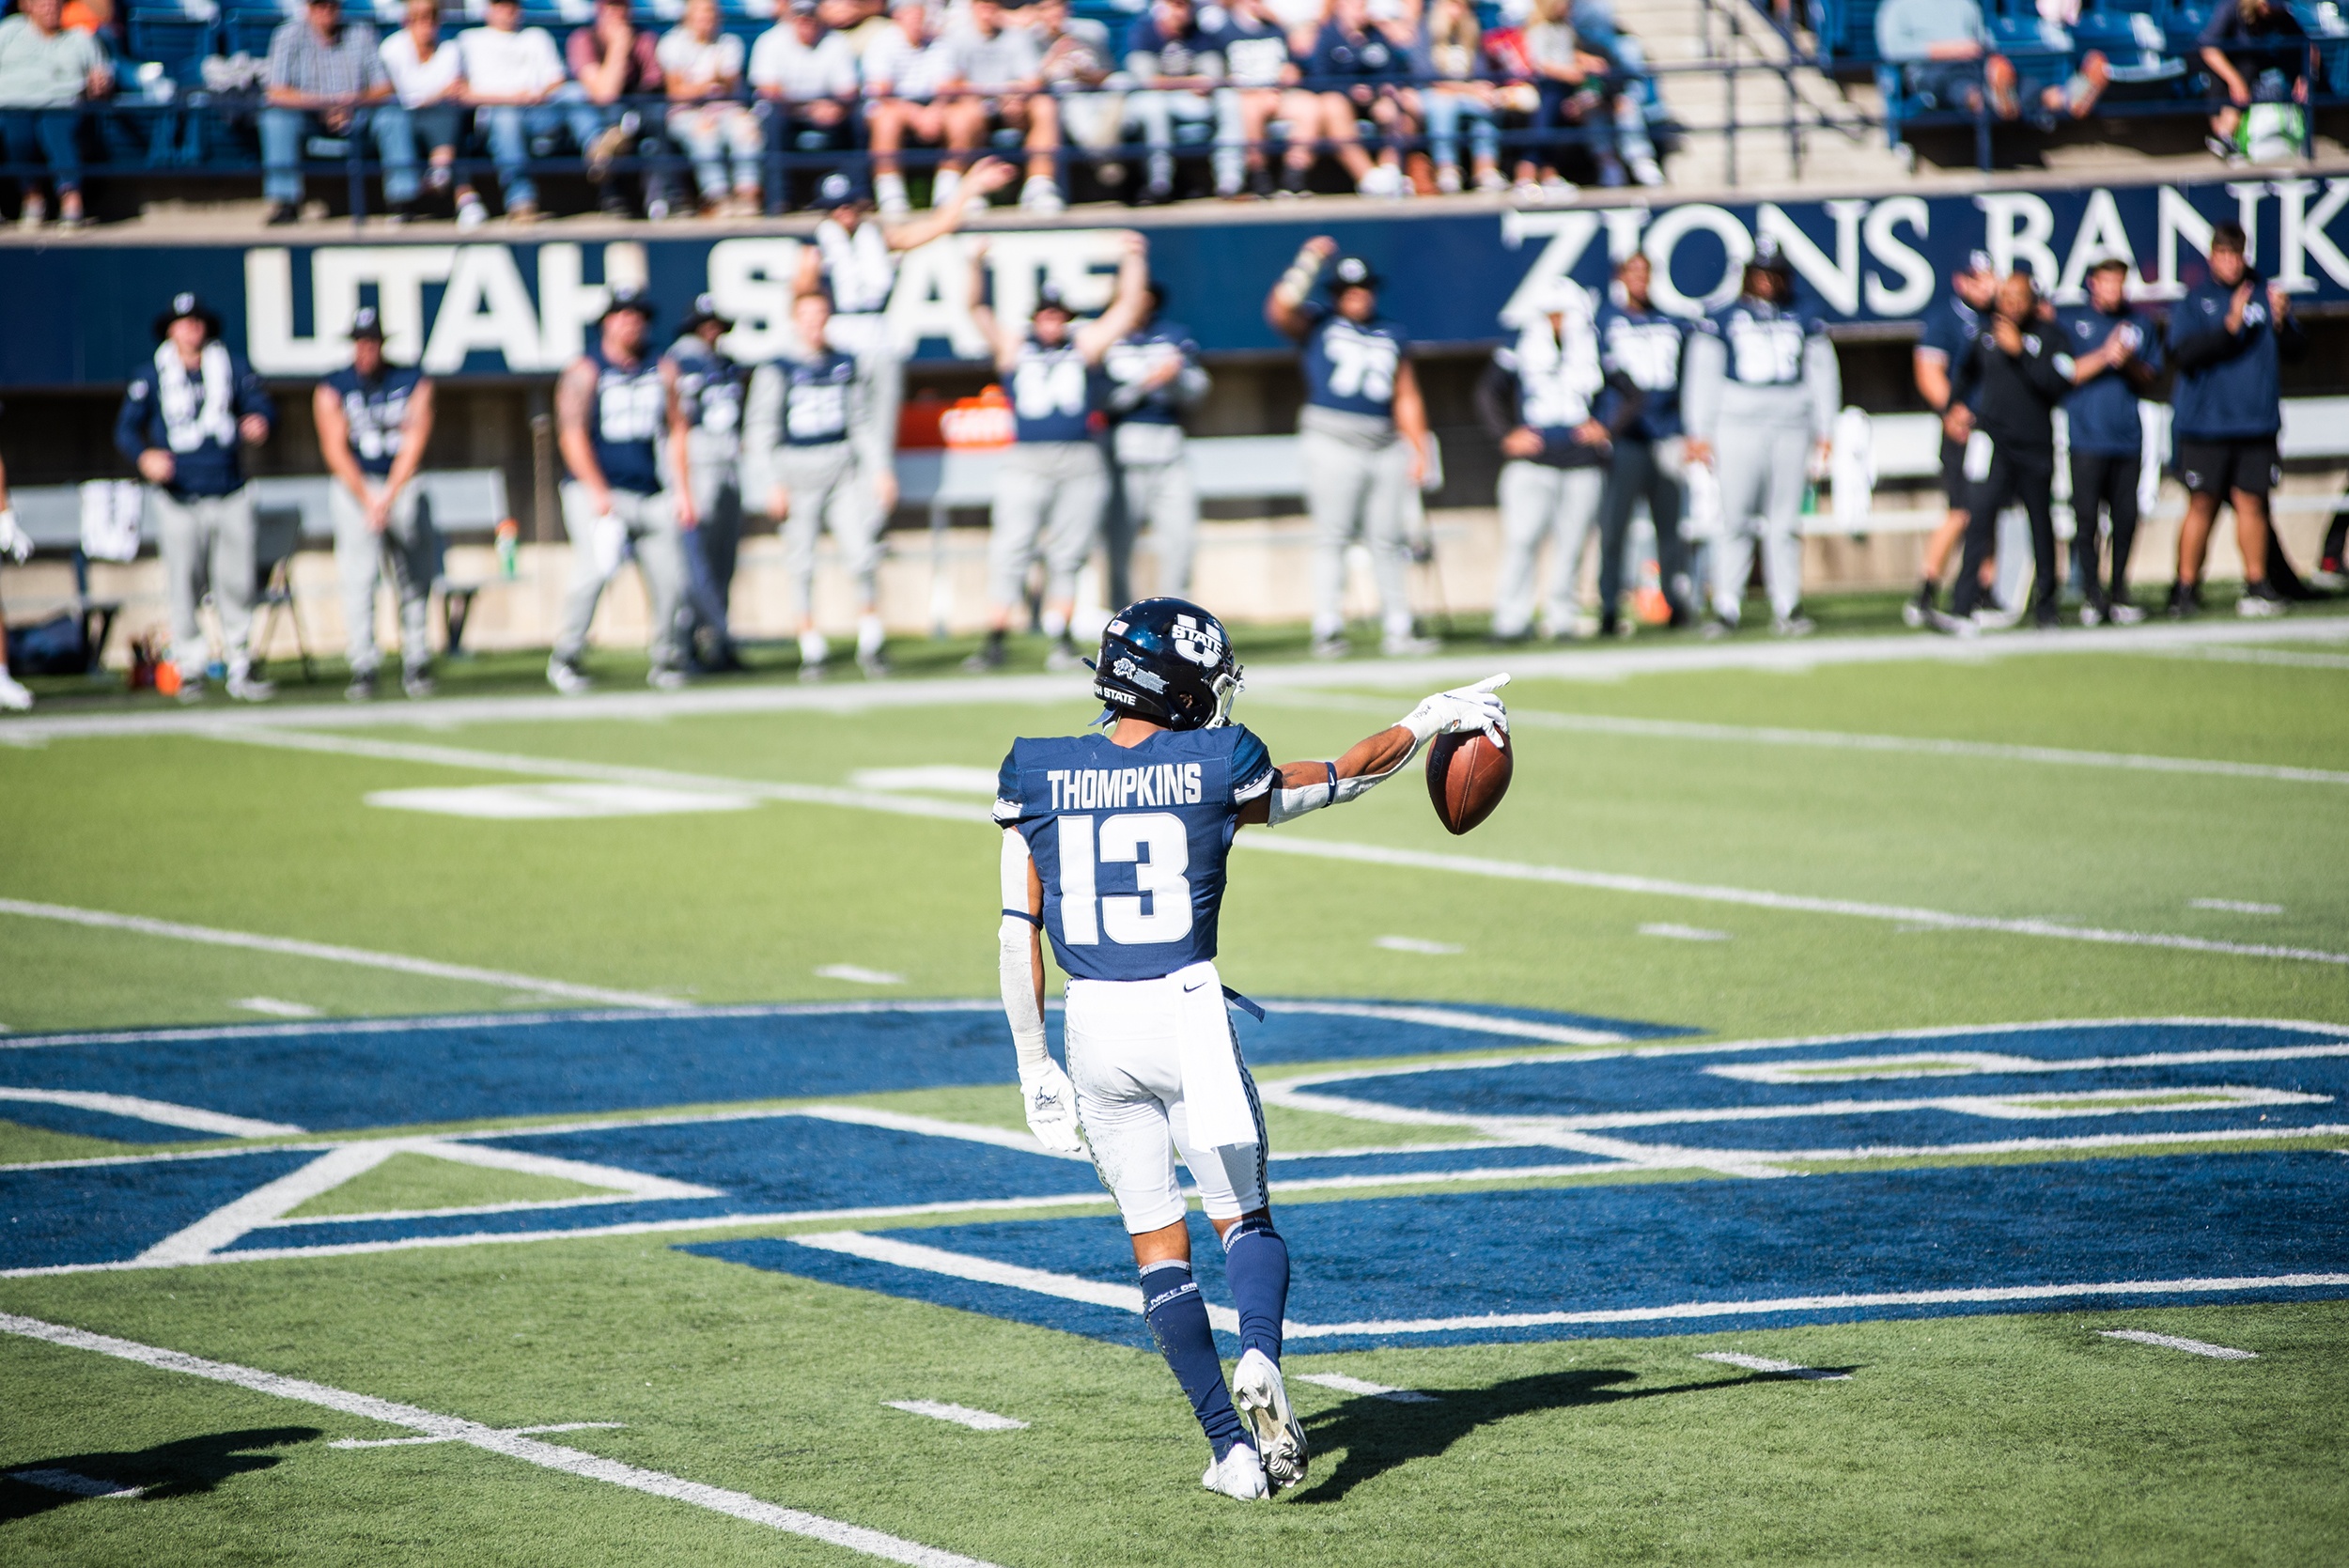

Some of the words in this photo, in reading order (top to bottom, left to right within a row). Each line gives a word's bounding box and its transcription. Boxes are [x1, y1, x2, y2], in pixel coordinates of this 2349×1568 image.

[1971, 177, 2349, 305] BANK
[244, 241, 648, 375] UTAH
[1171, 624, 1223, 660] STATE
[1103, 688, 1137, 706] STATE
[1047, 763, 1203, 810] THOMPKINS
[1057, 813, 1193, 946] 13
